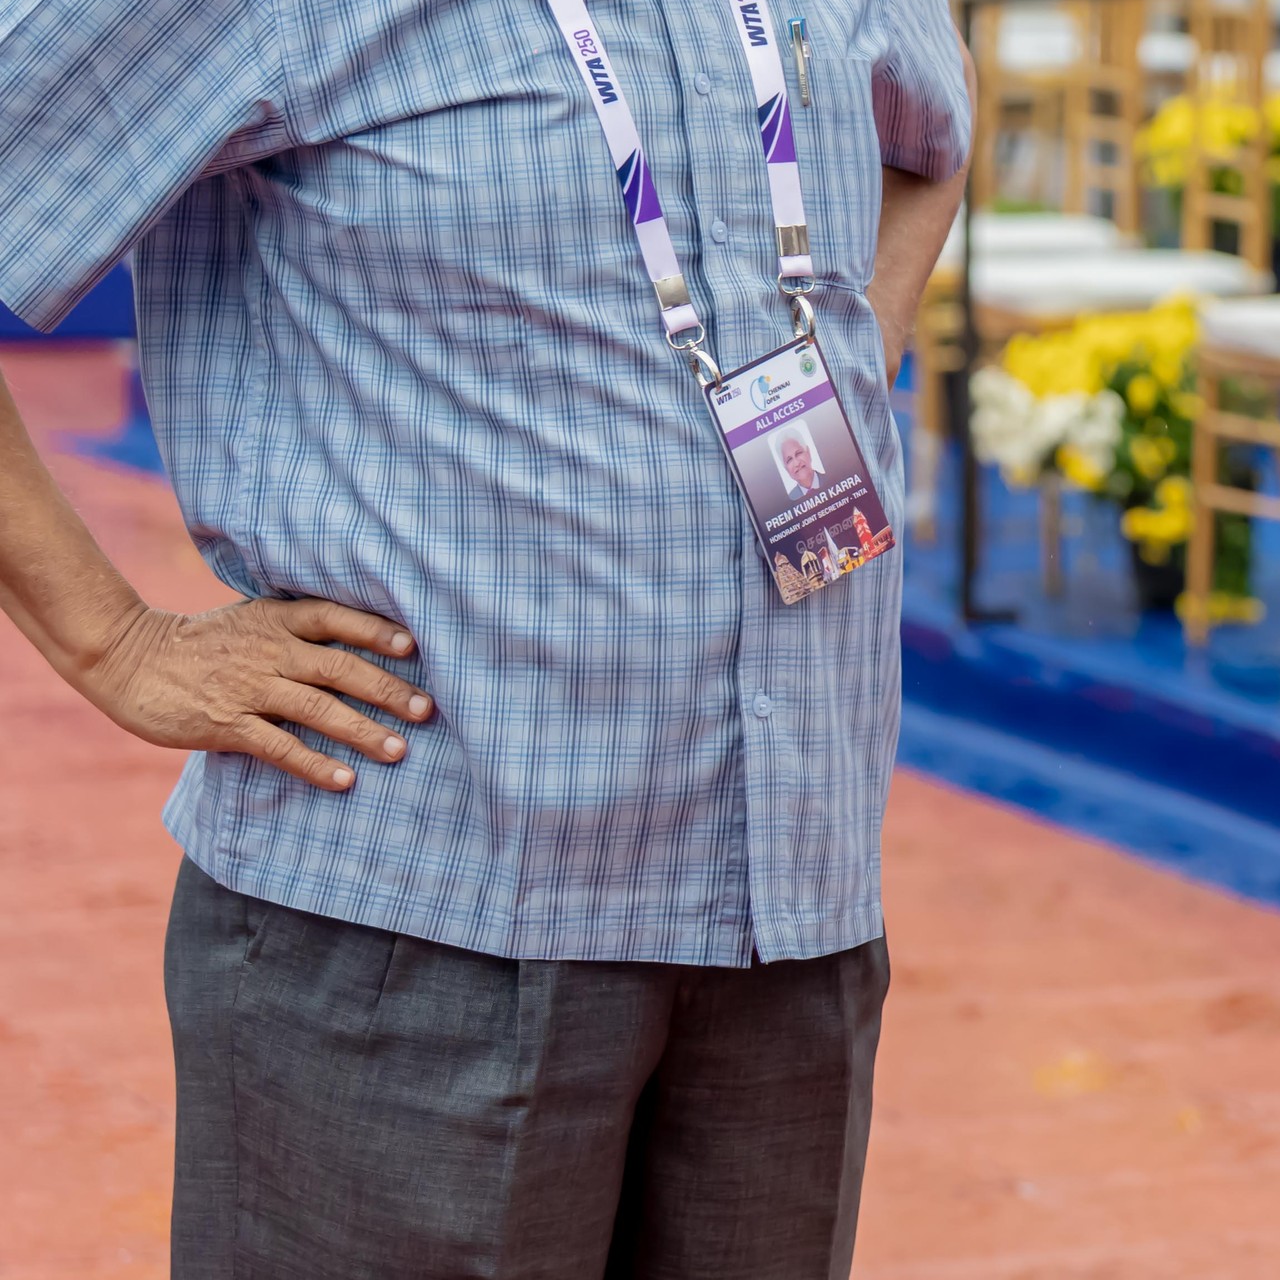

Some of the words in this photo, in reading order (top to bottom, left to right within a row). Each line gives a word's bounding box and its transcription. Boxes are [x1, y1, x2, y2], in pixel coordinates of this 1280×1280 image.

[739, 2, 768, 47] WTA
[573, 29, 598, 57] 250
[585, 56, 619, 104] WTA
[716, 391, 733, 406] WTA
[766, 394, 781, 405] OPEN
[767, 380, 791, 396] CHENNAI
[755, 415, 773, 432] ALL
[773, 398, 805, 422] ACCESS
[765, 510, 794, 532] PREM
[793, 491, 829, 518] KUMAR
[828, 474, 863, 499] KARRA
[769, 523, 802, 545] HONORARY
[801, 515, 818, 528] JOINT
[817, 497, 850, 519] SECRETARY
[852, 487, 868, 499] TNTA
